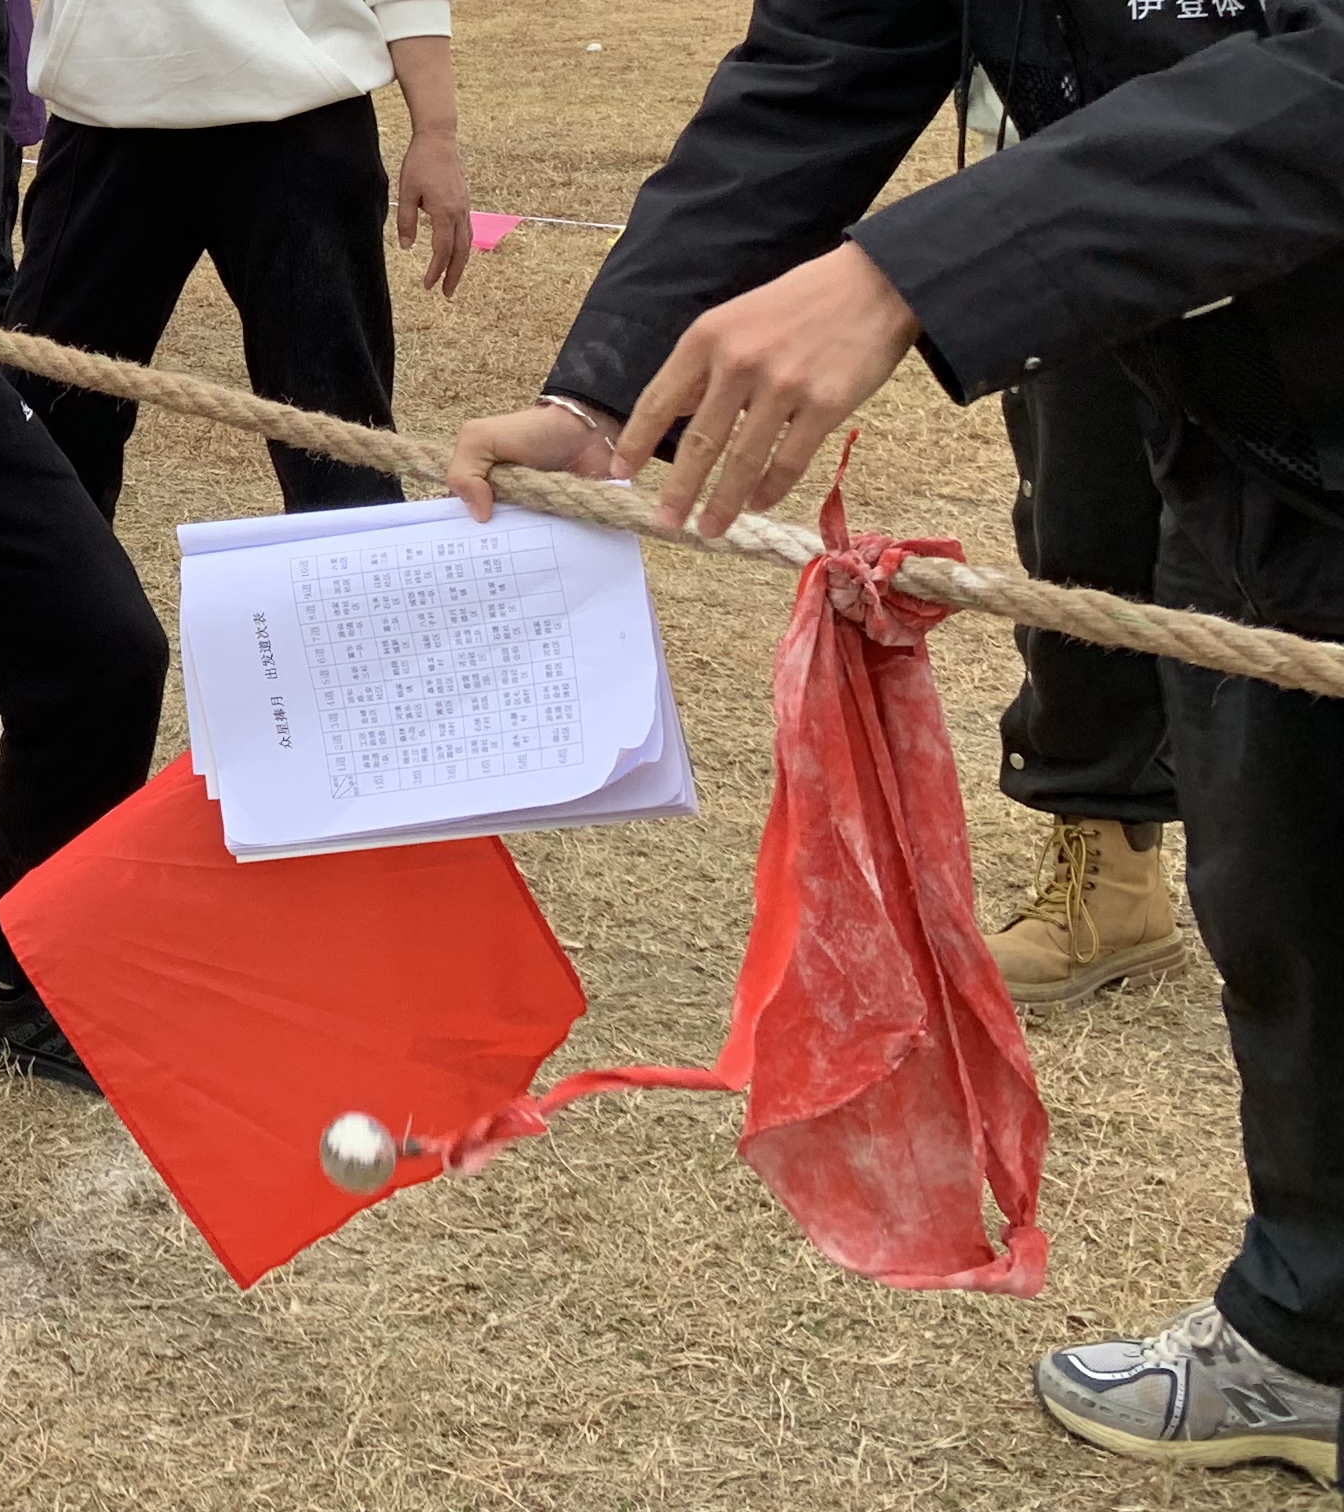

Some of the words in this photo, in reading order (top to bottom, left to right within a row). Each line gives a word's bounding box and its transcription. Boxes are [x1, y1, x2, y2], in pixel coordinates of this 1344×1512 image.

[253, 612, 278, 679] 出发道次表
